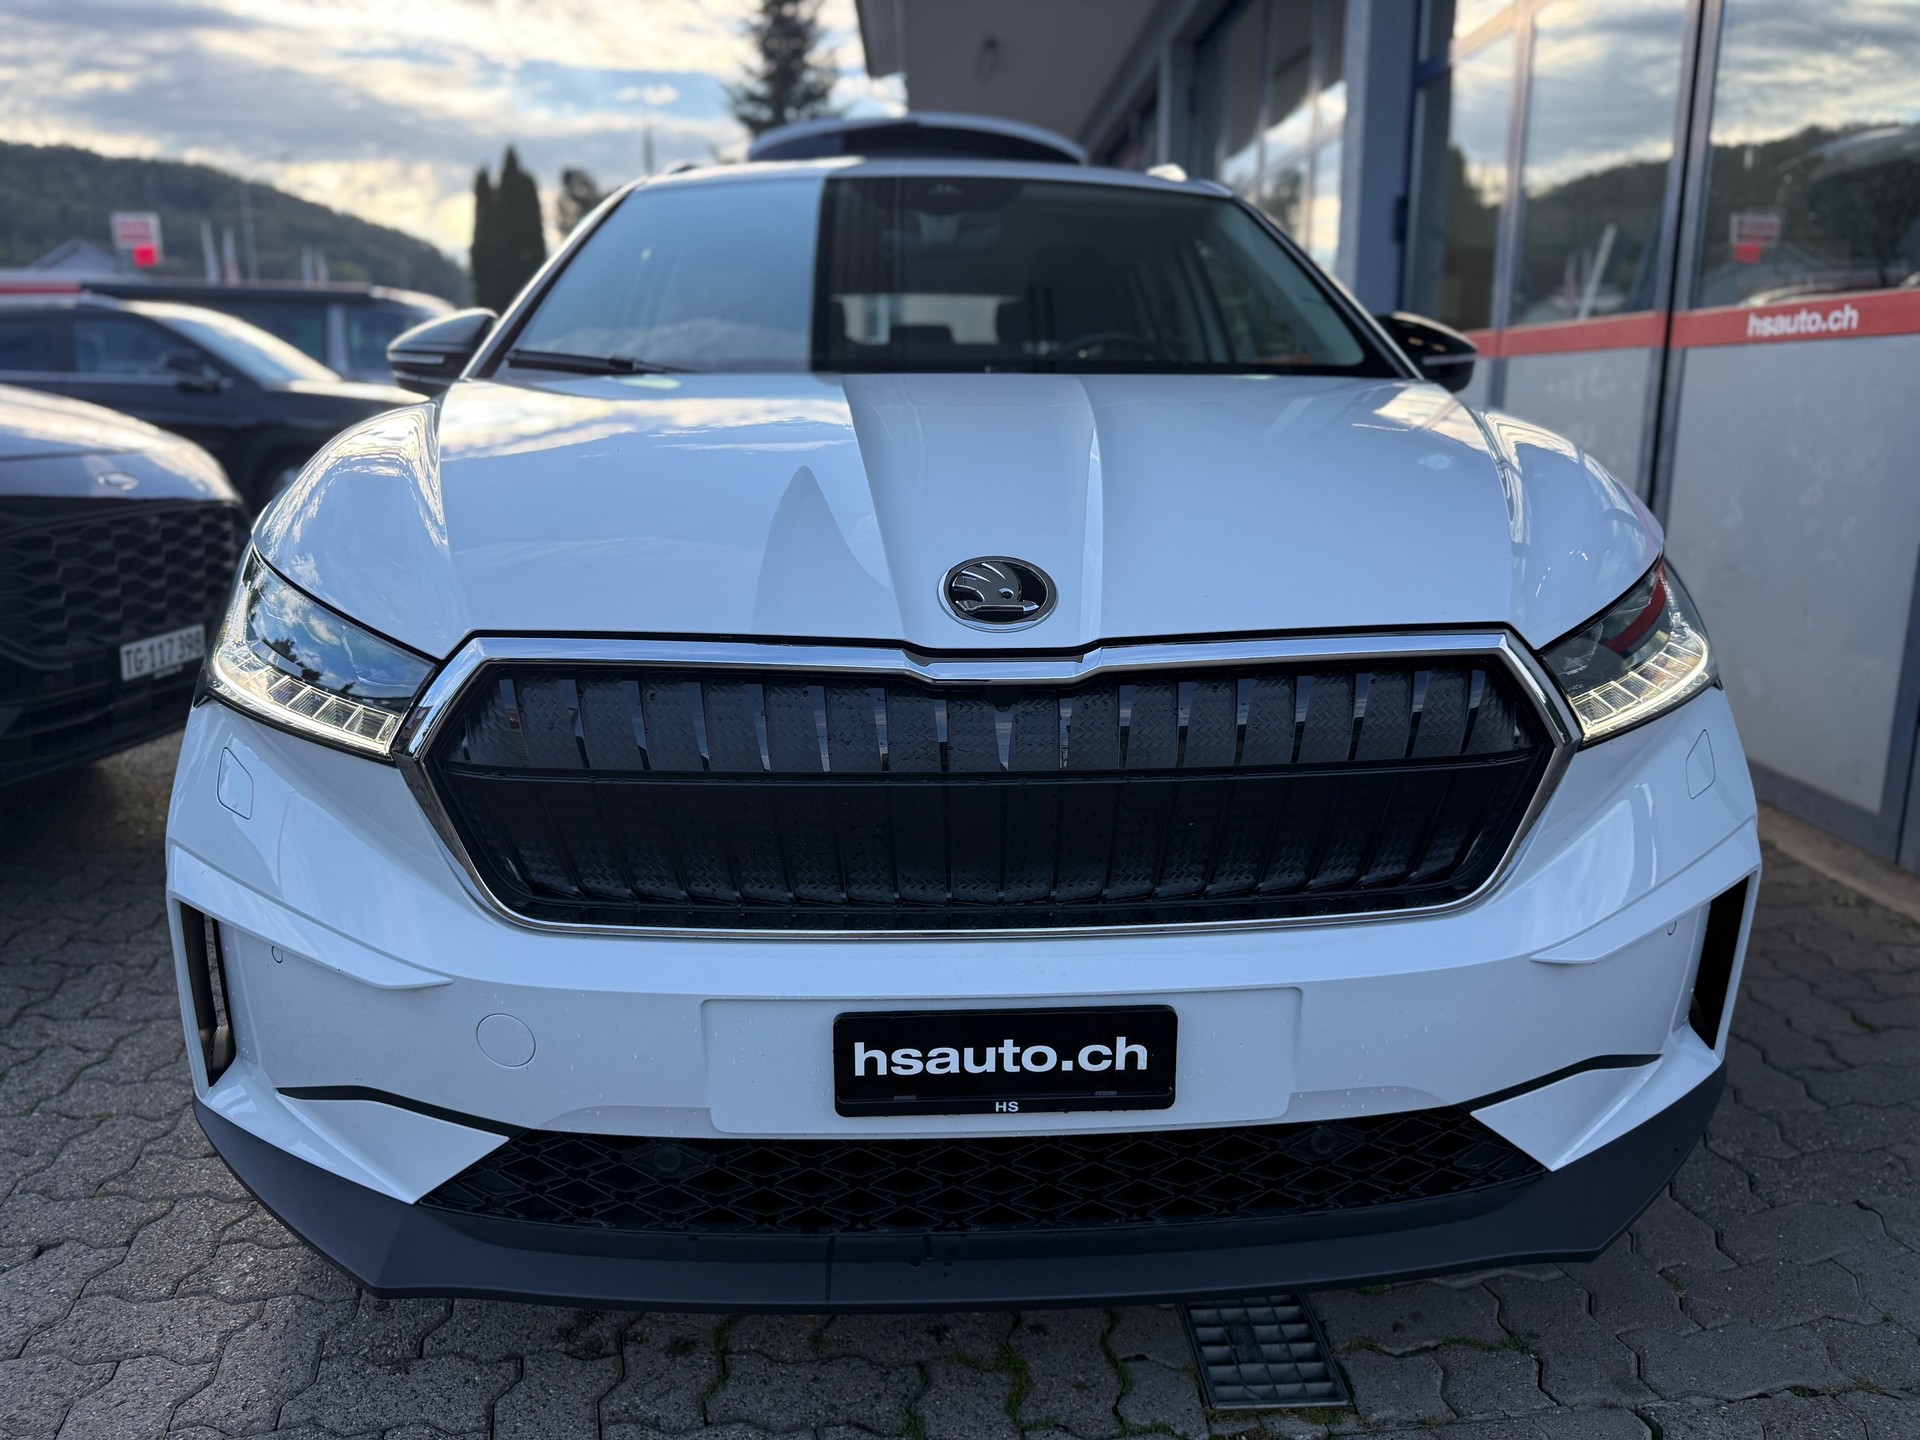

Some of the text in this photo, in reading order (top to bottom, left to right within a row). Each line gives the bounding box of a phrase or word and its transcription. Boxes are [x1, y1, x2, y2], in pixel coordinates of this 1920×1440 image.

[1747, 303, 1859, 338] hsauto.ch
[854, 1036, 1148, 1077] hsauto.ch
[995, 1101, 1019, 1113] HS
